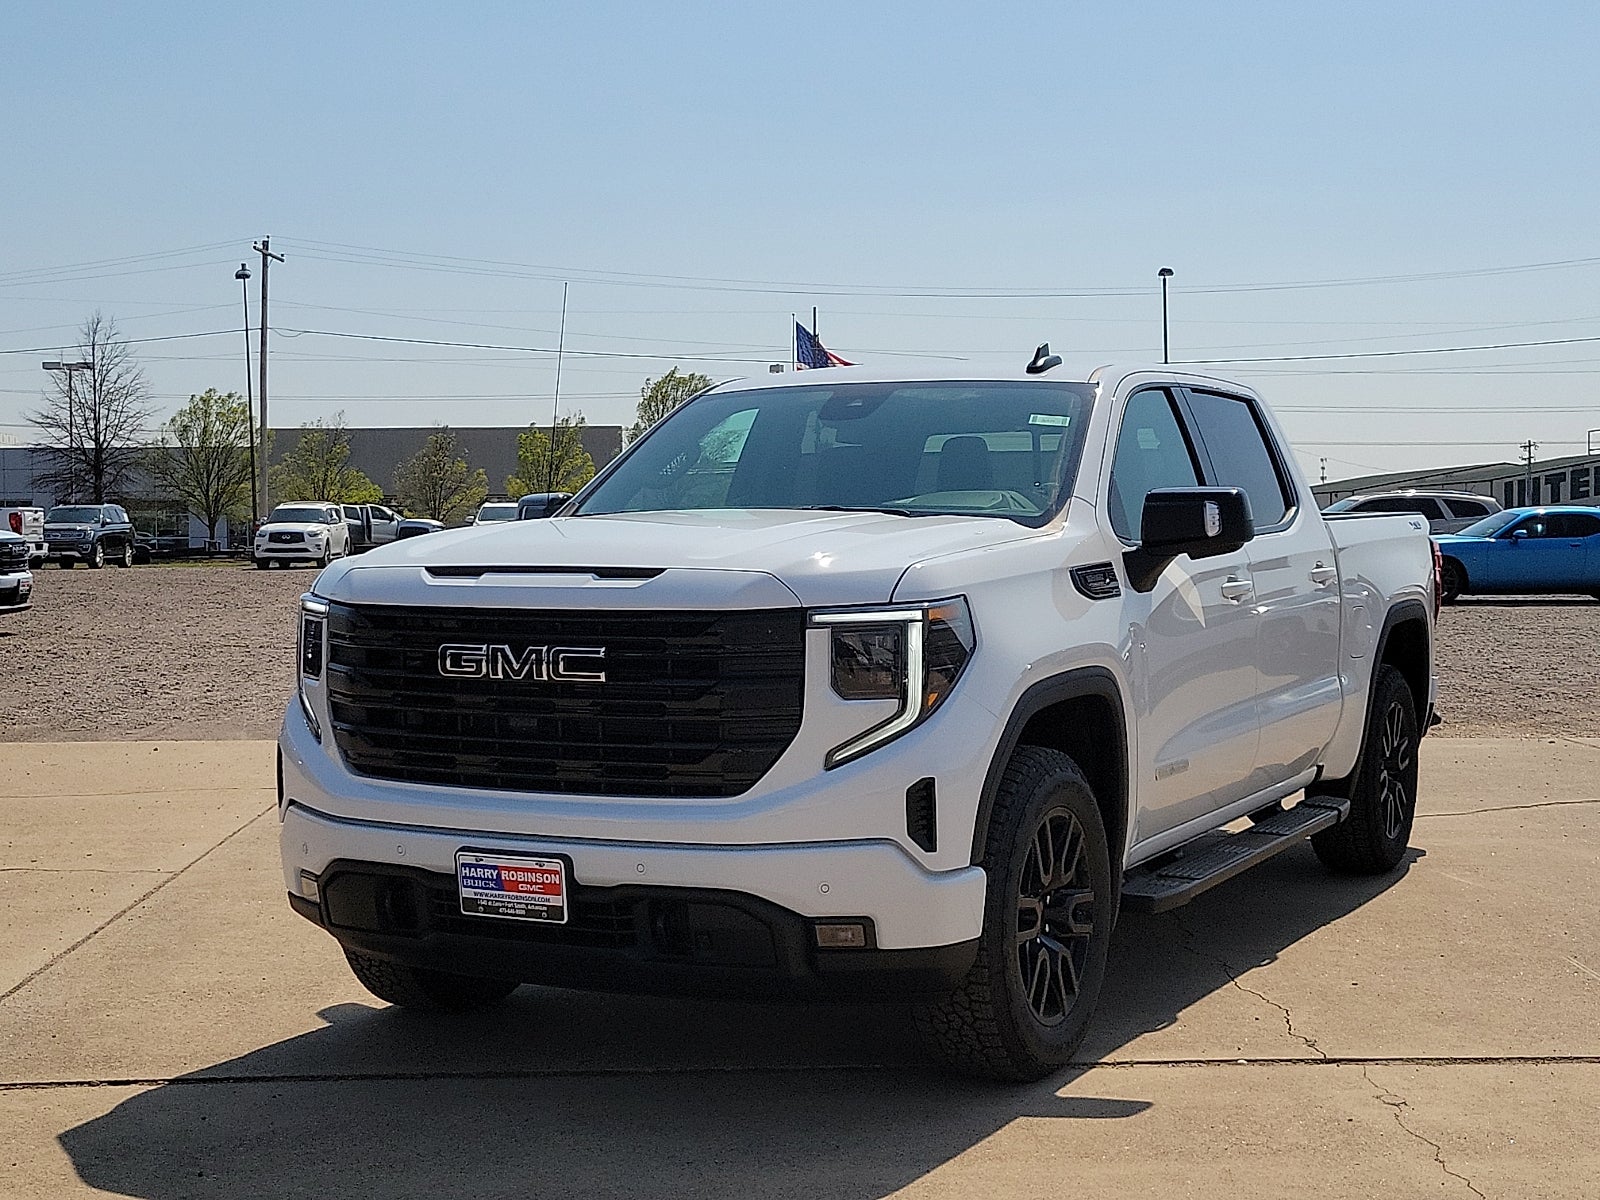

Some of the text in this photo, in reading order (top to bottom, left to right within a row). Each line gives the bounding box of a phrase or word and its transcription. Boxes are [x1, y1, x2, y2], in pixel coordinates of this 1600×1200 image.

[438, 643, 606, 682] GMC
[462, 866, 560, 885] HARRY ROBINSON
[463, 878, 498, 889] BUICK
[518, 883, 545, 892] GMC
